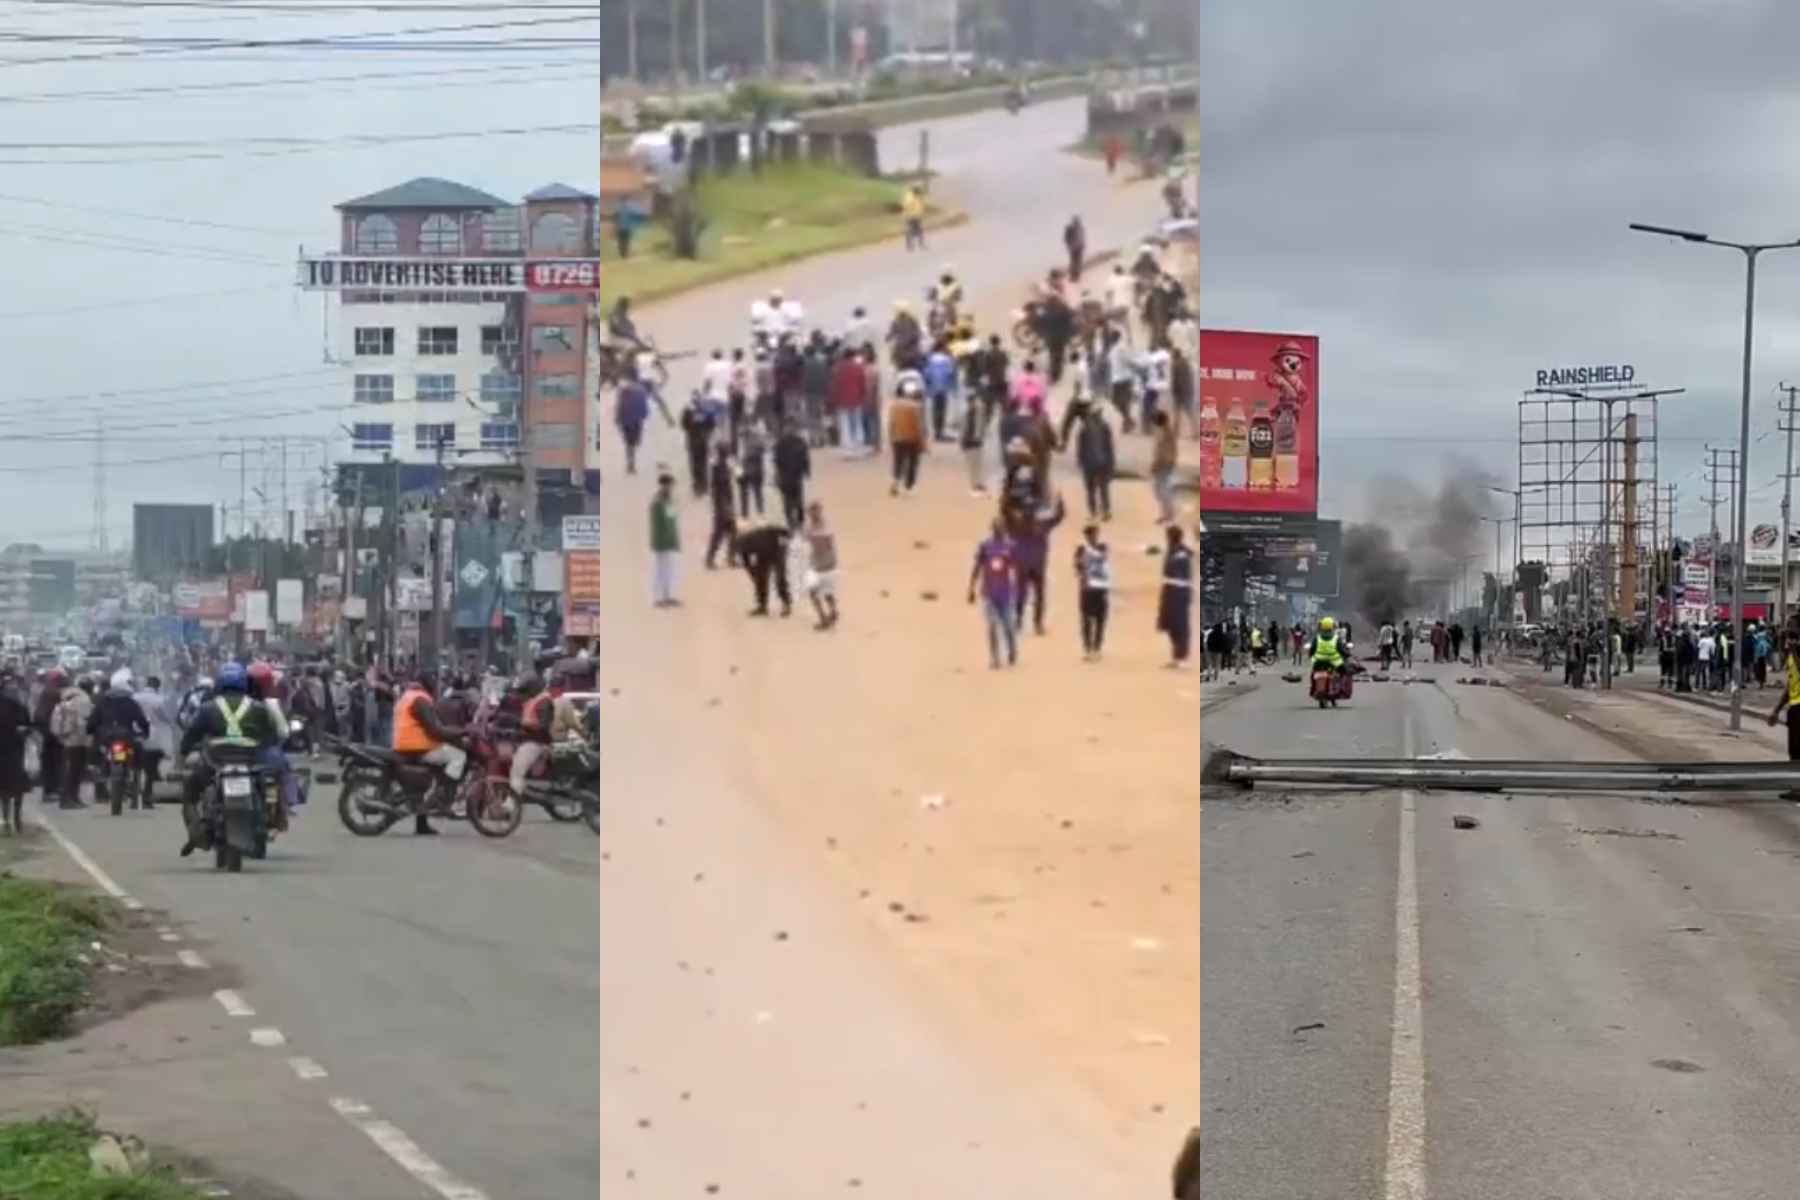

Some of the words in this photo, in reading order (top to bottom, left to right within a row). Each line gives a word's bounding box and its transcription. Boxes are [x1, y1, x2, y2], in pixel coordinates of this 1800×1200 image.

[307, 261, 333, 286] TO
[341, 261, 456, 287] ADVERTISE
[463, 262, 516, 287] HERE
[1536, 364, 1635, 386] RAINSHIELD
